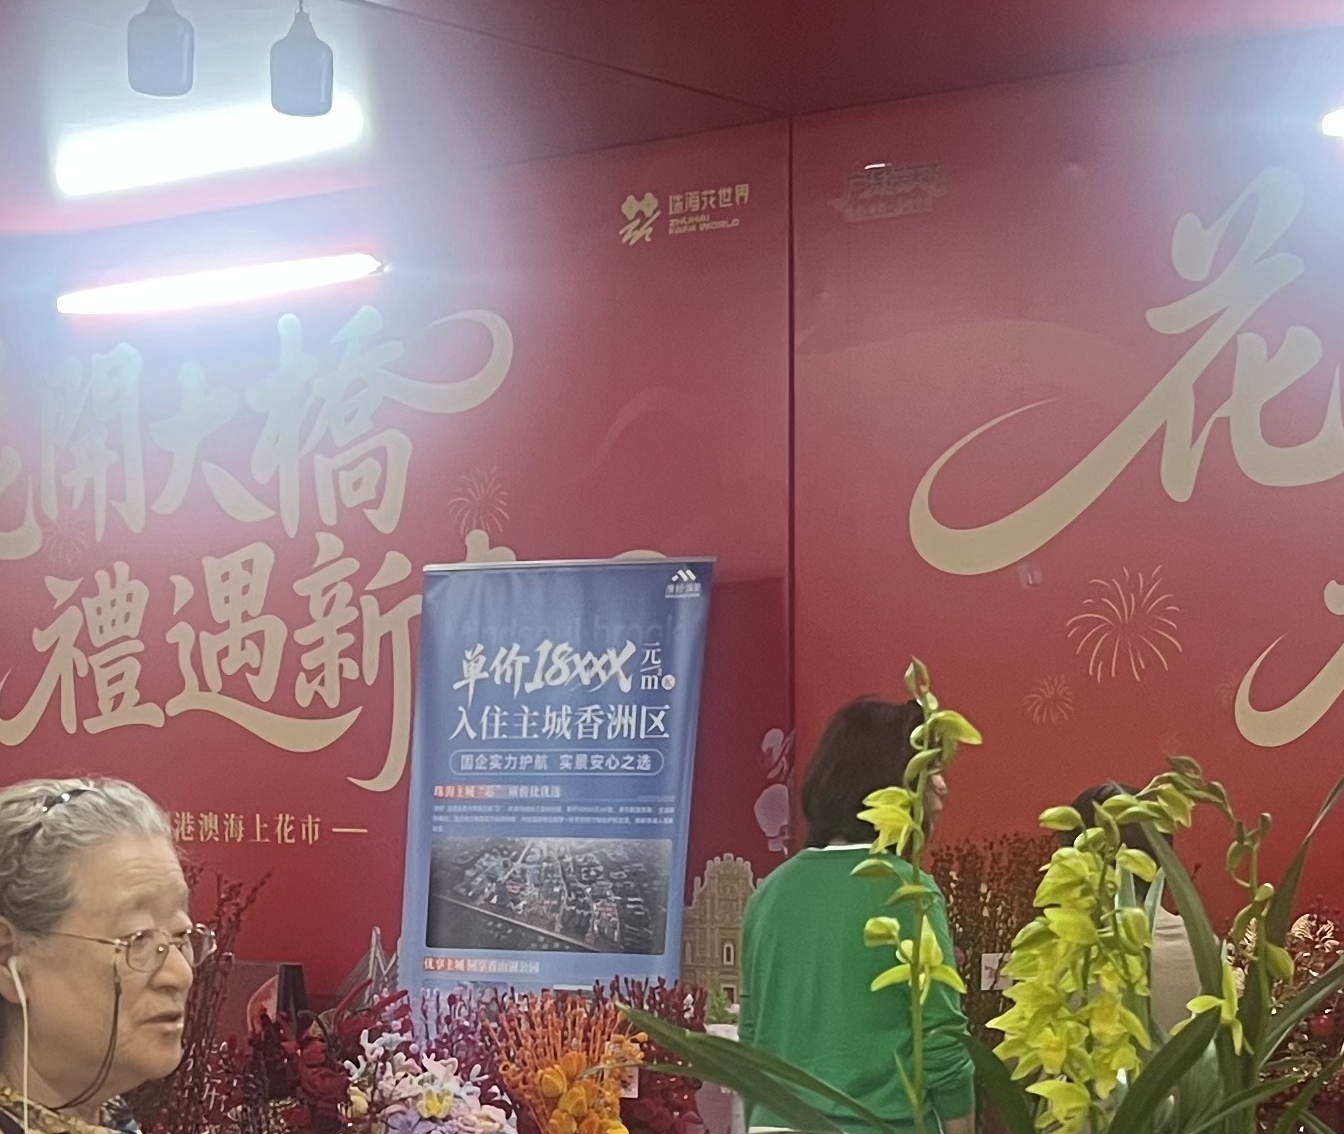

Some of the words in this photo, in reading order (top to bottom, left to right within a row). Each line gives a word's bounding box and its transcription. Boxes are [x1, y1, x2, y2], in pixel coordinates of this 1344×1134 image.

[448, 704, 670, 741] 入住主城香洲区
[460, 754, 548, 771] 国企实力护航
[559, 754, 652, 771] 实景安心之选
